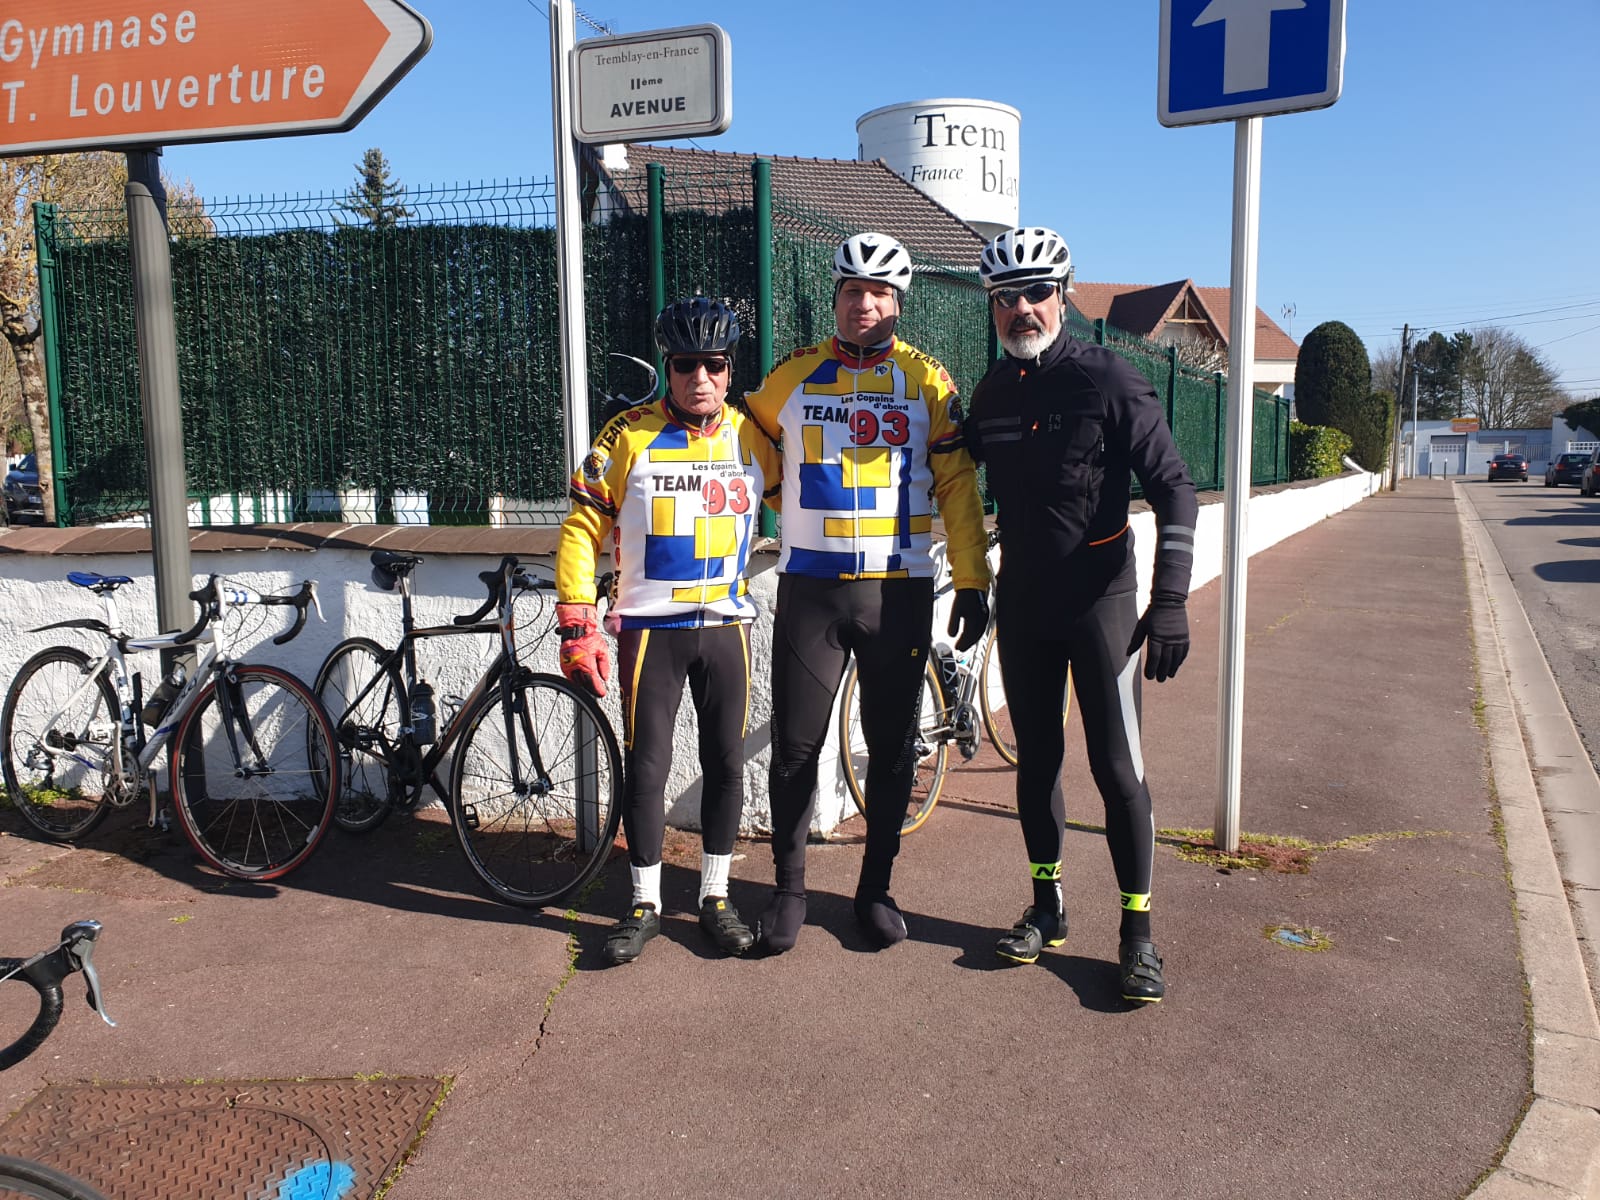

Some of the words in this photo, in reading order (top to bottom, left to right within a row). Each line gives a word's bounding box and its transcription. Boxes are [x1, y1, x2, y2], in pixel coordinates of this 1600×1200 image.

[0, 10, 197, 69] Gymnase
[595, 46, 700, 66] Tremblay-en-France
[2, 81, 37, 124] T.
[69, 64, 326, 119] Louverture
[610, 96, 686, 118] AVENUE
[914, 112, 1006, 151] Trem
[911, 165, 963, 183] France
[856, 394, 894, 403] Copains
[873, 402, 909, 411] d'abord
[597, 416, 630, 451] TEAM
[803, 405, 849, 424] TEAM
[848, 409, 910, 446] 93
[652, 475, 702, 492] TEAM
[702, 477, 751, 515] 93
